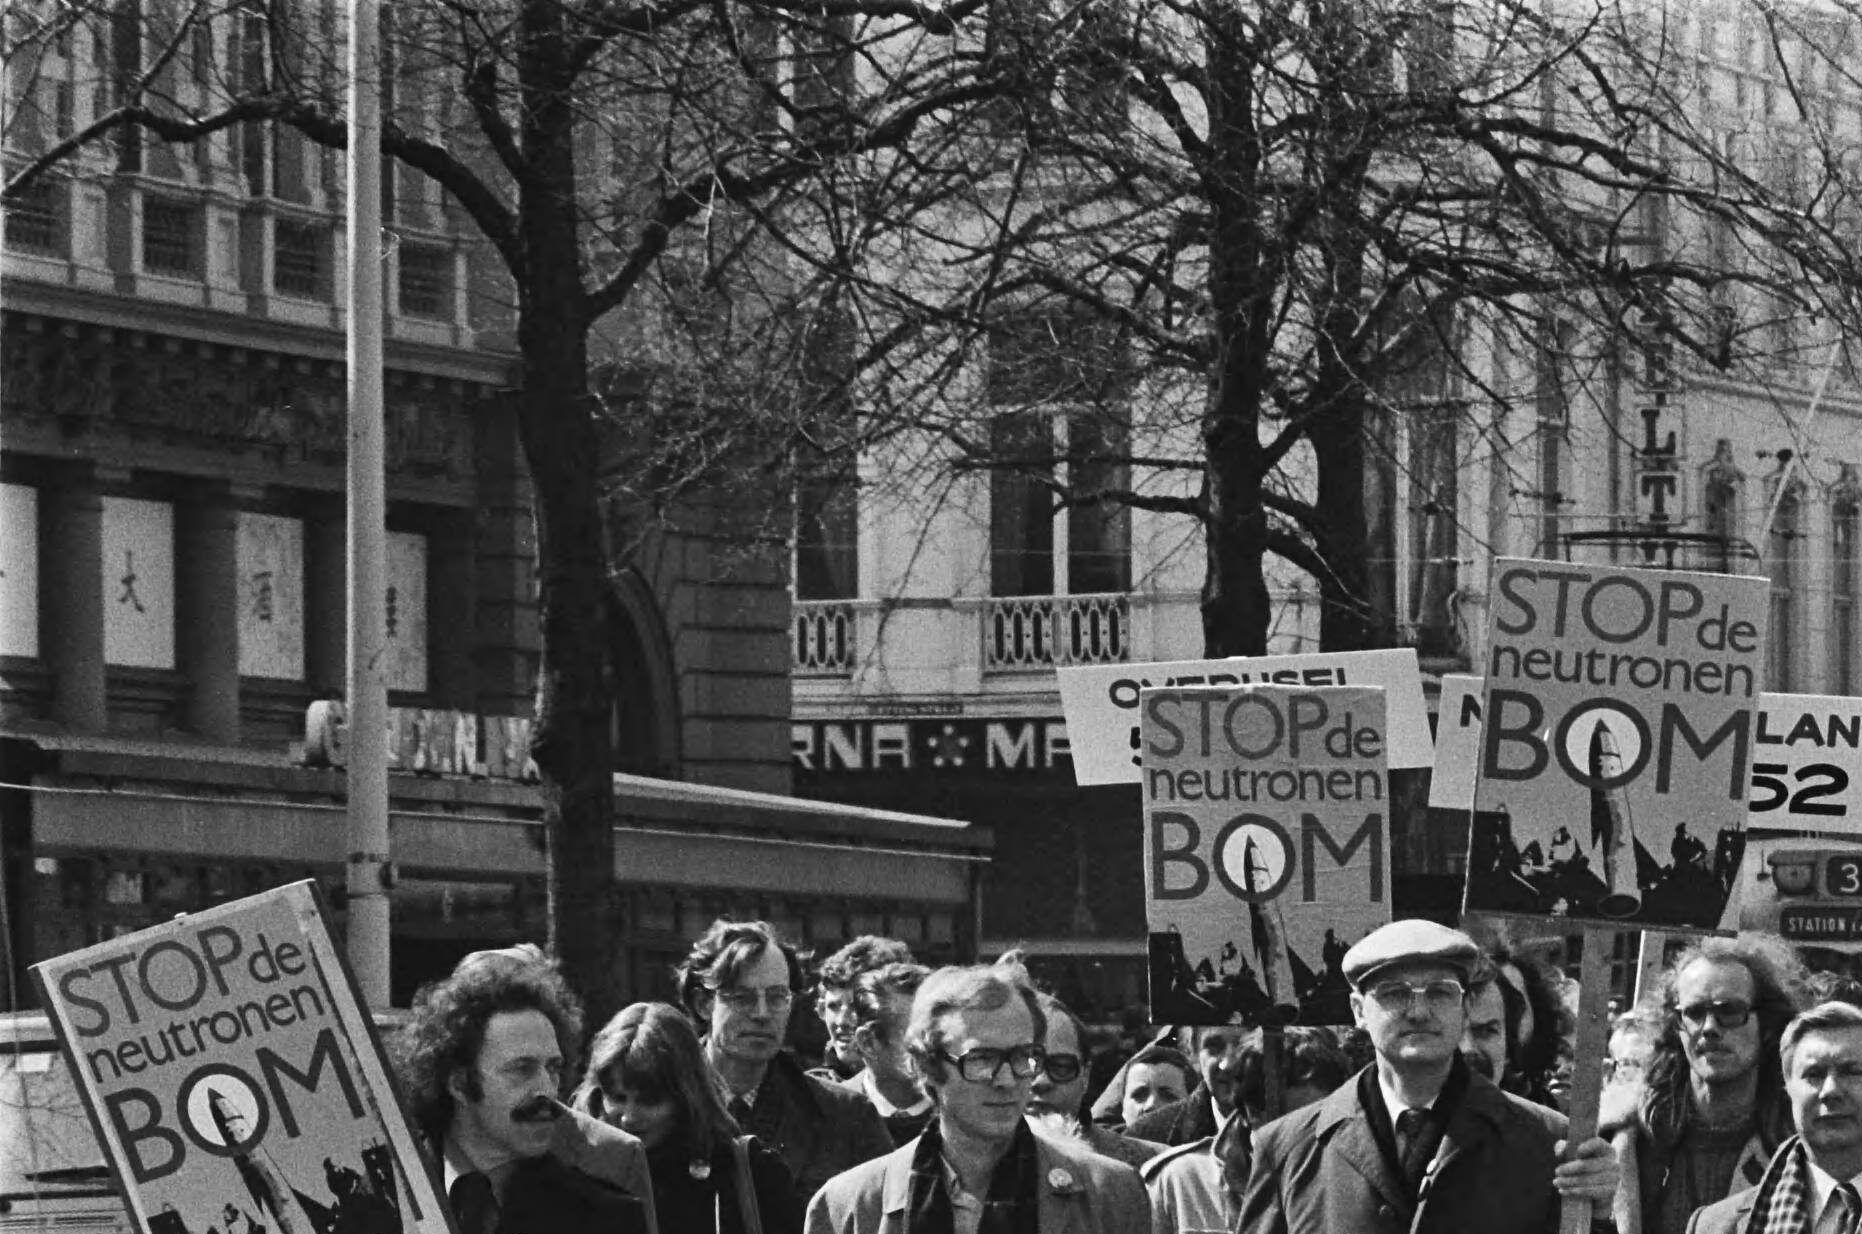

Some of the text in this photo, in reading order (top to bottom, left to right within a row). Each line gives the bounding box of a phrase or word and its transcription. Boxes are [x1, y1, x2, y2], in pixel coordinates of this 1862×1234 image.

[1496, 568, 1757, 652] STOP de
[1492, 645, 1752, 697] neutronen
[1149, 693, 1329, 760] STOP
[1325, 711, 1381, 758] de
[1484, 688, 1751, 801] BOM
[1150, 766, 1382, 801] neutronen
[1151, 811, 1384, 903] BOM
[1840, 863, 1860, 893] 3
[59, 925, 307, 1038] STOP de
[87, 985, 324, 1083] neutronen
[104, 1028, 366, 1185] BOM
